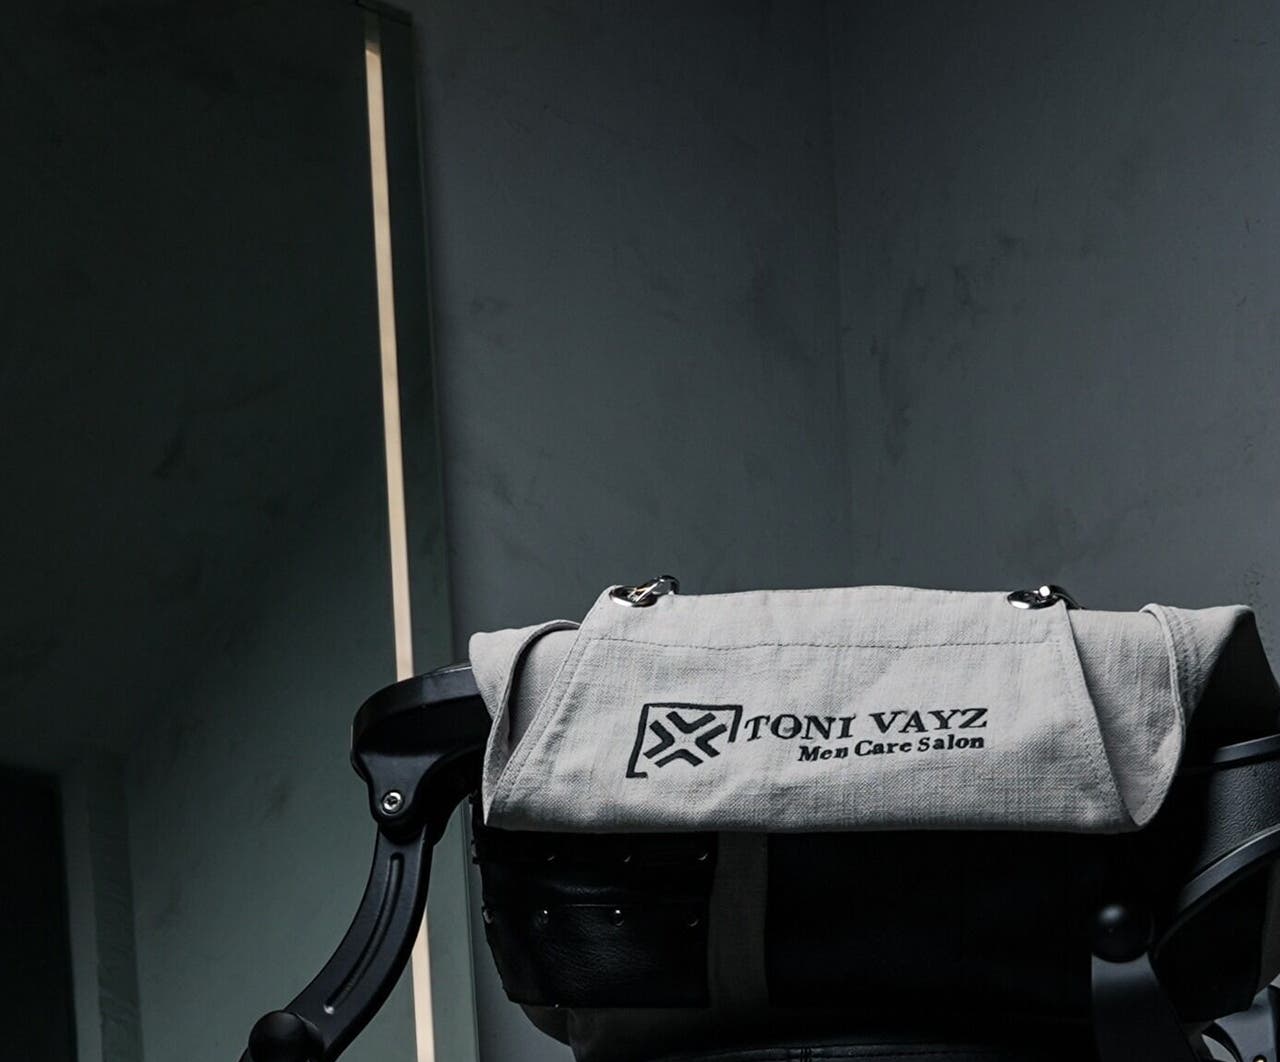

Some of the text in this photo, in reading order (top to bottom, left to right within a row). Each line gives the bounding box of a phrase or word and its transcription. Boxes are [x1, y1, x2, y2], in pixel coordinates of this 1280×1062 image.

[745, 708, 988, 741] TONI VAYZ
[798, 734, 985, 762] Men Care Salon
